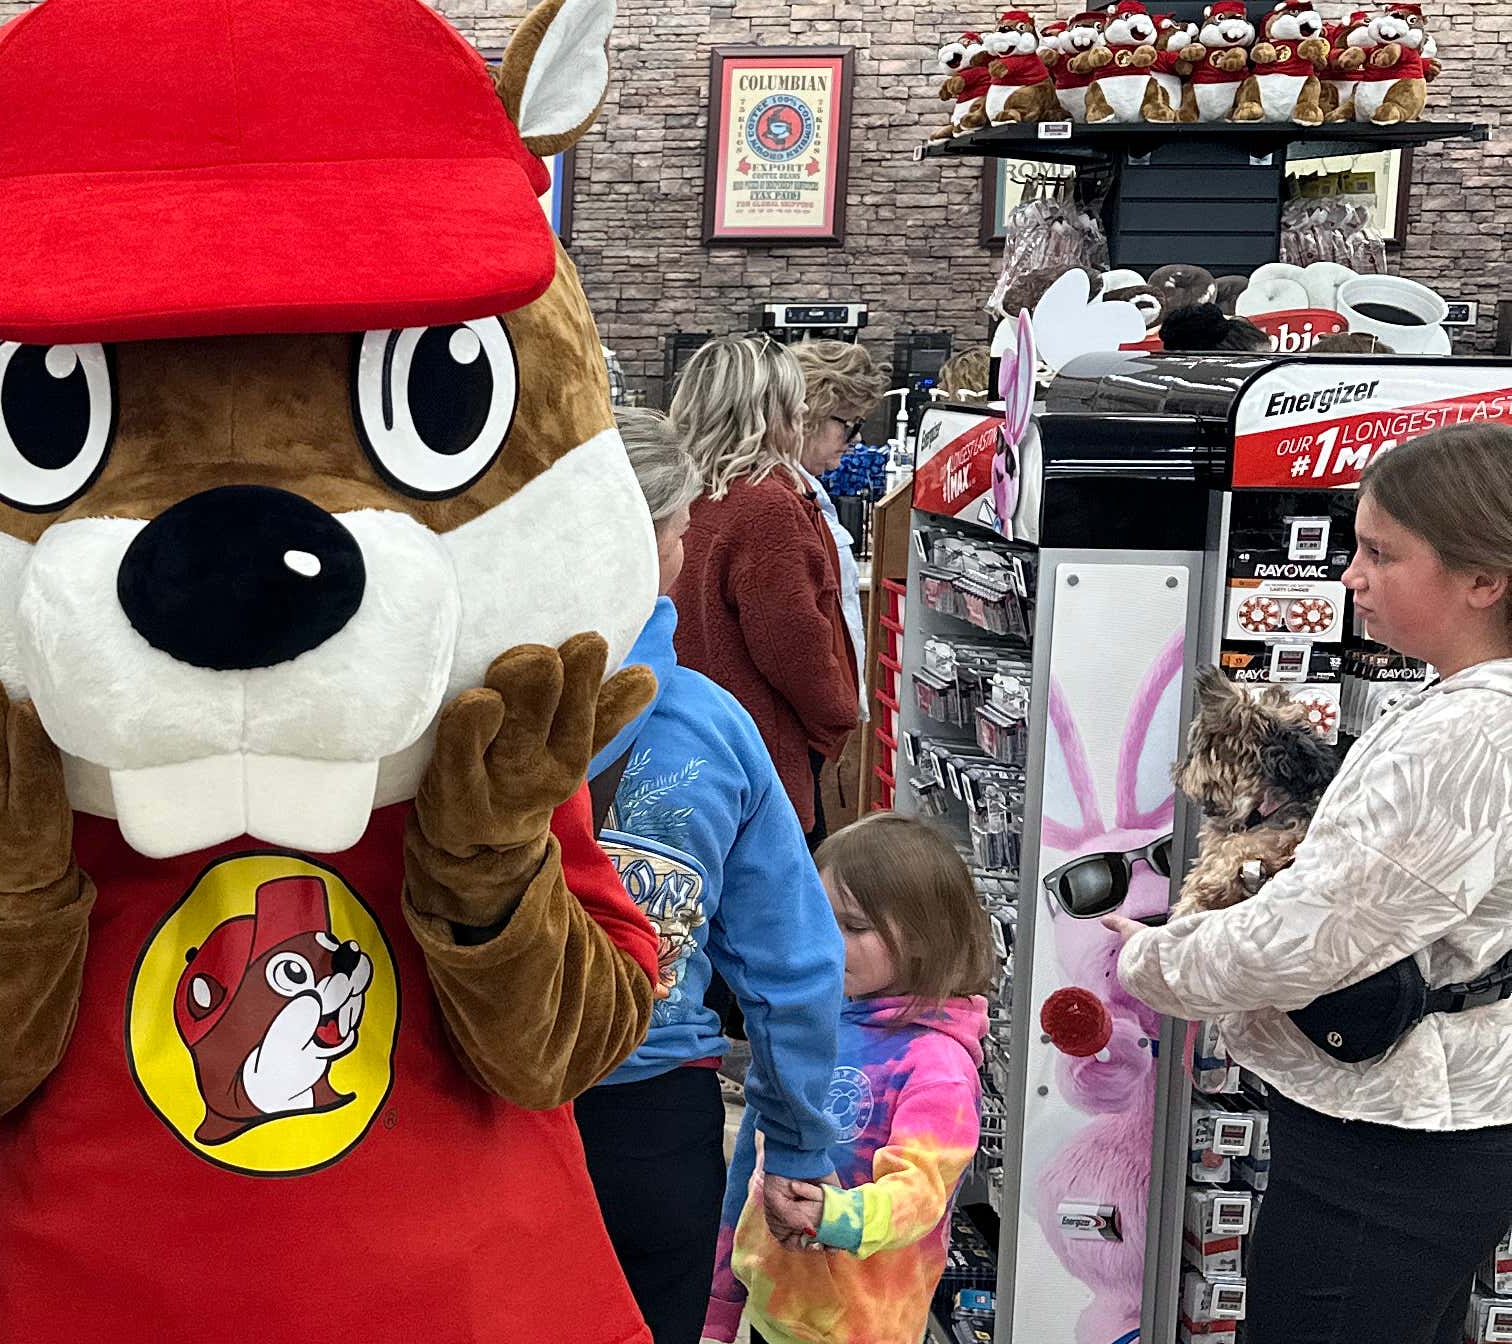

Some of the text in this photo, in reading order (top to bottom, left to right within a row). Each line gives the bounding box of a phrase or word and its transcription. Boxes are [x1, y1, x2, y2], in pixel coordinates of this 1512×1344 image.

[739, 75, 827, 91] COLUMBIAN
[752, 163, 804, 172] EXPORT
[1264, 379, 1380, 418] Energizer
[1276, 395, 1512, 478] OUR #1 LONGEST LAST
[1254, 563, 1329, 578] RAYOVAC
[1235, 668, 1270, 680] RAYO
[1376, 668, 1426, 679] RAYOVA
